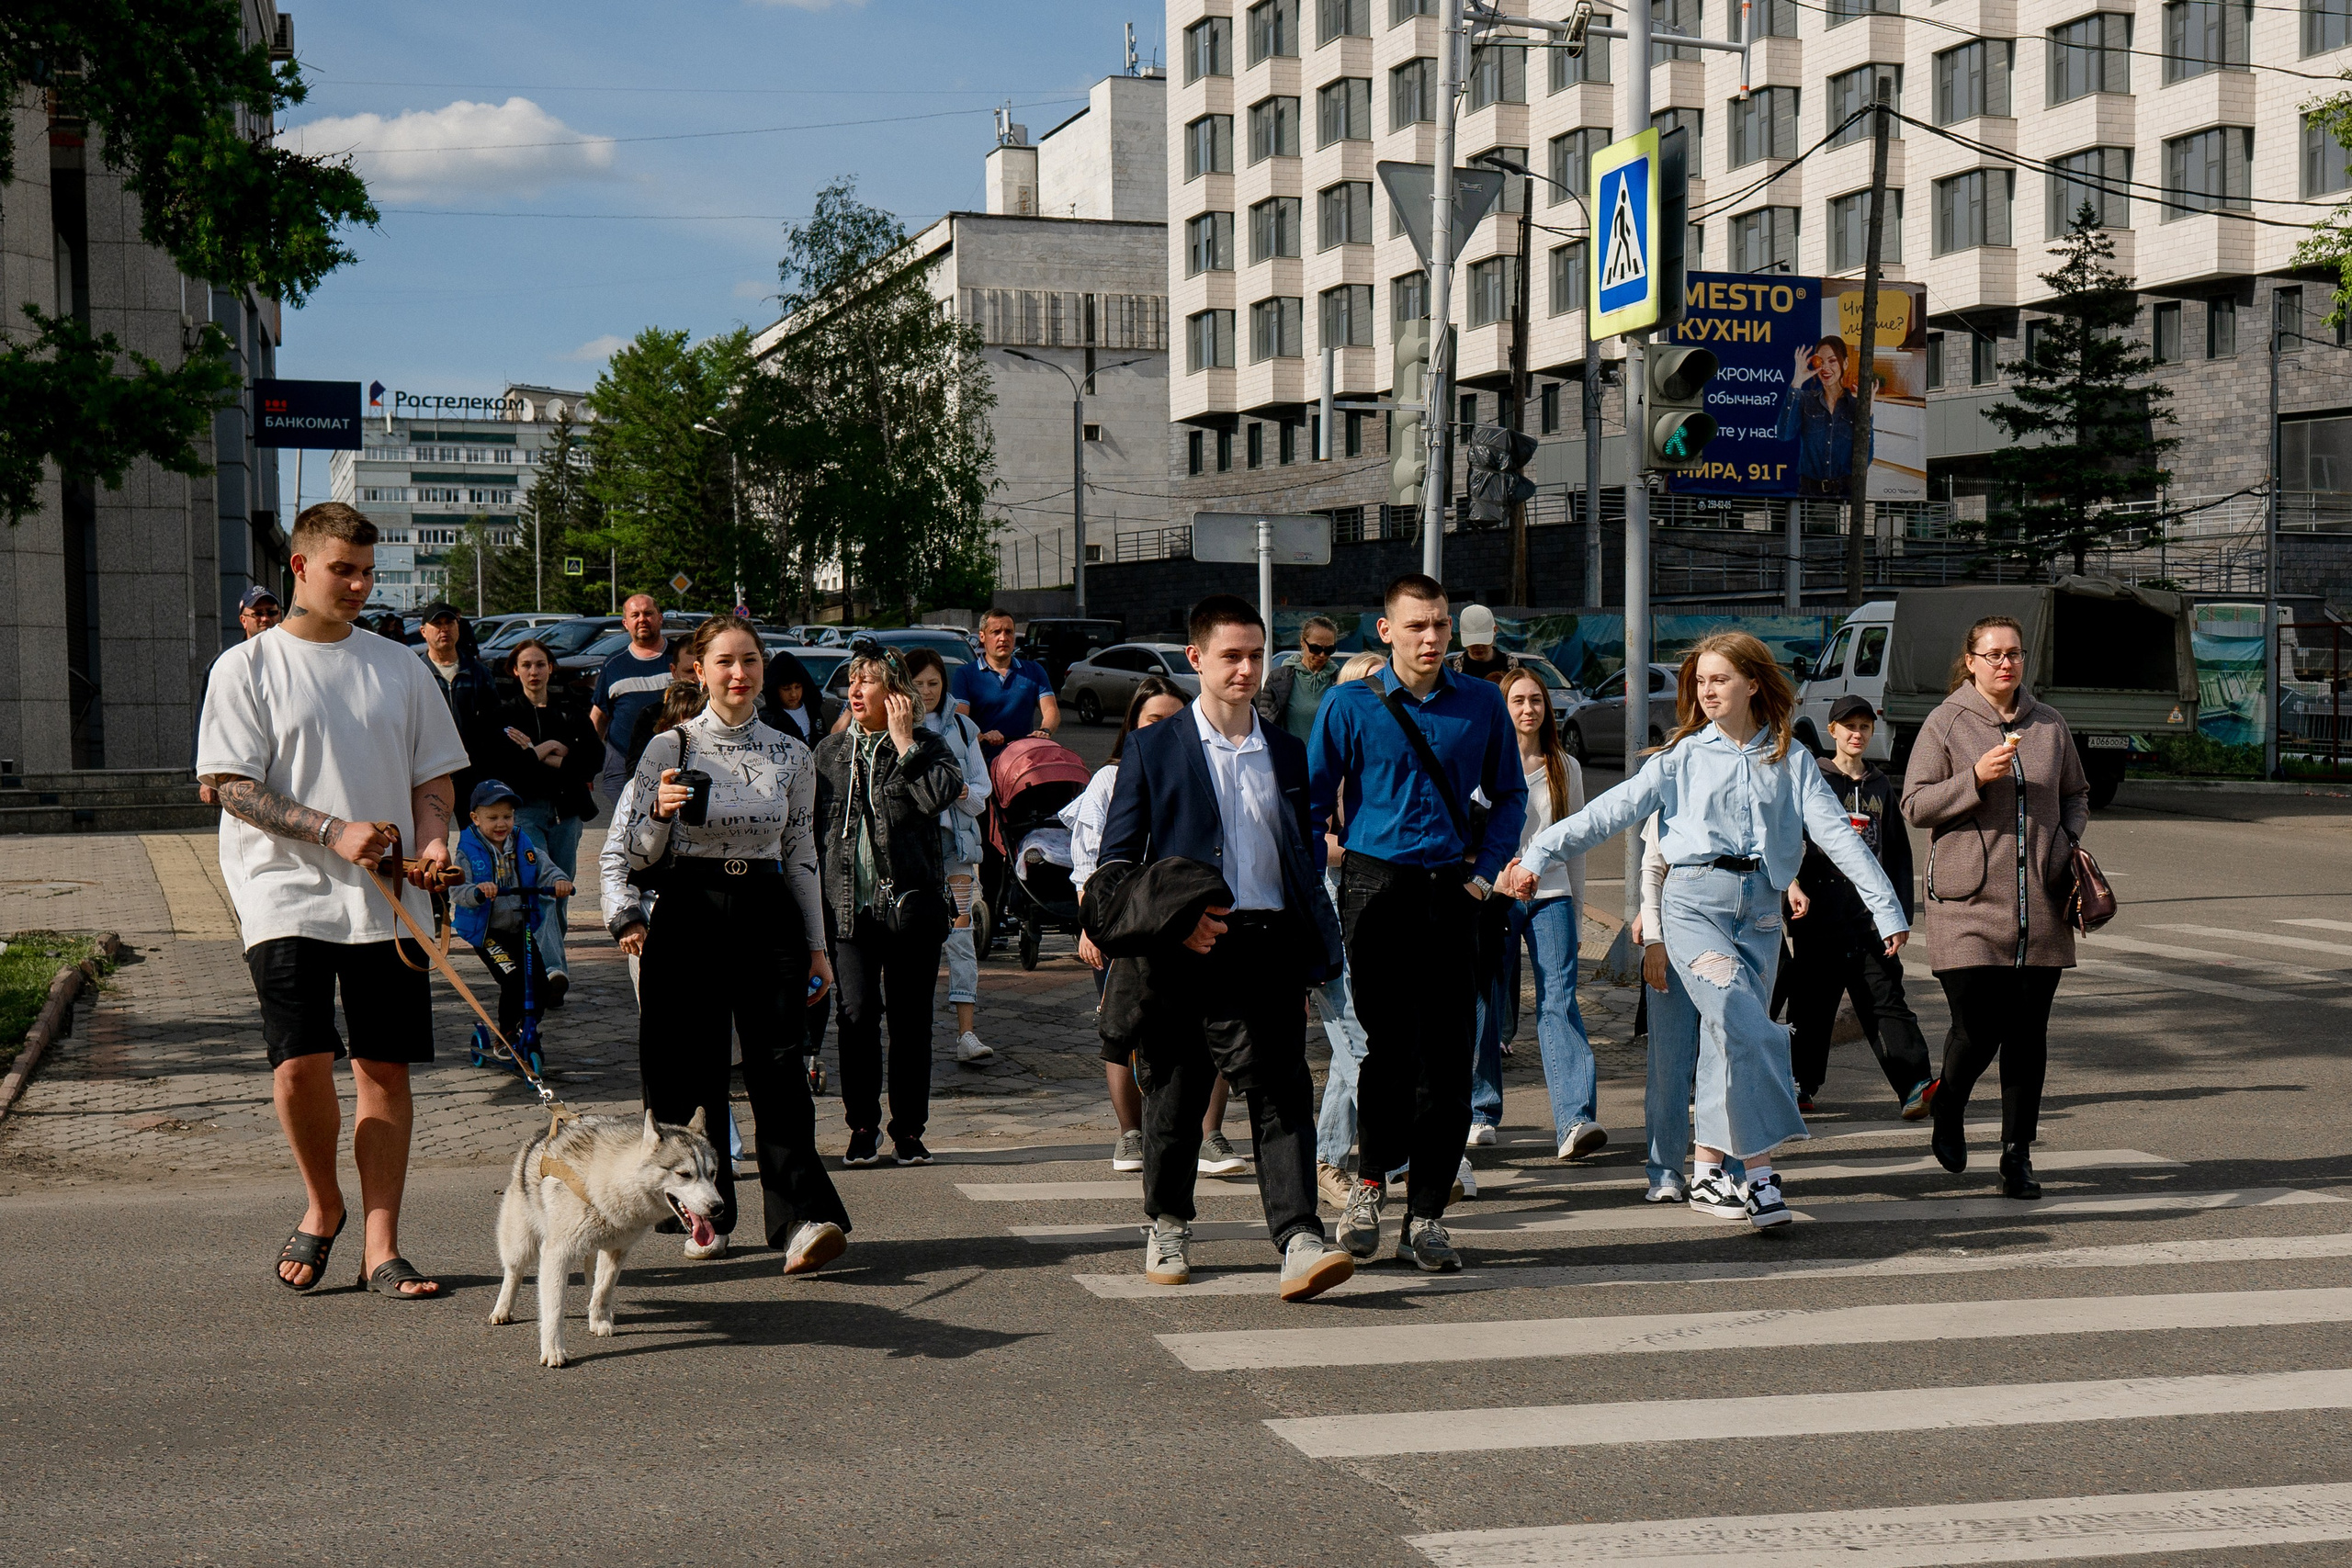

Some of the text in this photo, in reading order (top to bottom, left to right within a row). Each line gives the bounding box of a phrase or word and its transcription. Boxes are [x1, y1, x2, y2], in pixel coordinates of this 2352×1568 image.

[1677, 318, 1771, 343] КУХНИ
[395, 390, 525, 411] Ростелеком
[1707, 390, 1778, 405] обычная?
[265, 416, 350, 430] БАНКОМАТ
[1737, 427, 1747, 441] у
[1749, 425, 1778, 438] нас!
[1747, 464, 1770, 479] 91
[1776, 464, 1788, 480] Г
[526, 852, 536, 862] R
